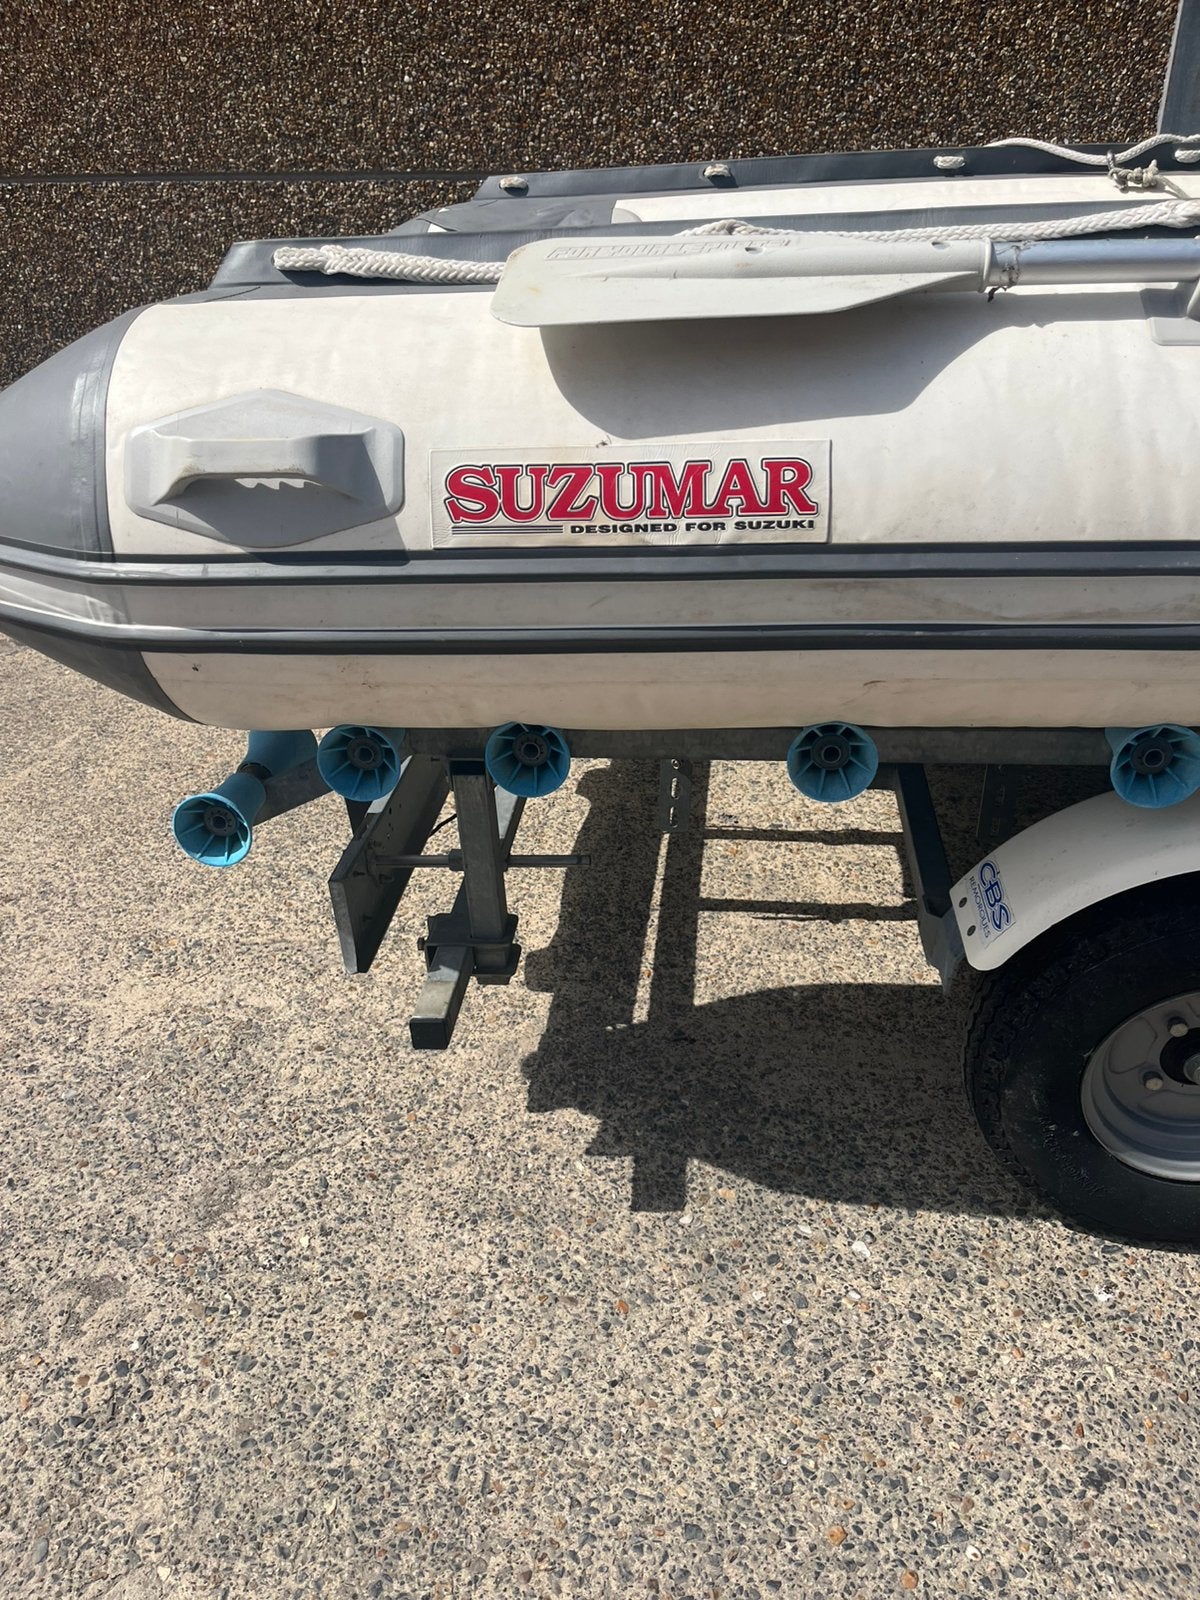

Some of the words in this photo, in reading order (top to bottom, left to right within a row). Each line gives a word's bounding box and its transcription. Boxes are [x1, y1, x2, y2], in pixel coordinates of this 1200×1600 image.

[445, 457, 818, 524] SUZUMAR
[570, 523, 677, 534] DESIGNED
[686, 521, 726, 532] FOR
[734, 519, 814, 531] SUZUKI
[970, 876, 991, 938] REMORQUES
[980, 861, 1010, 931] CBS
